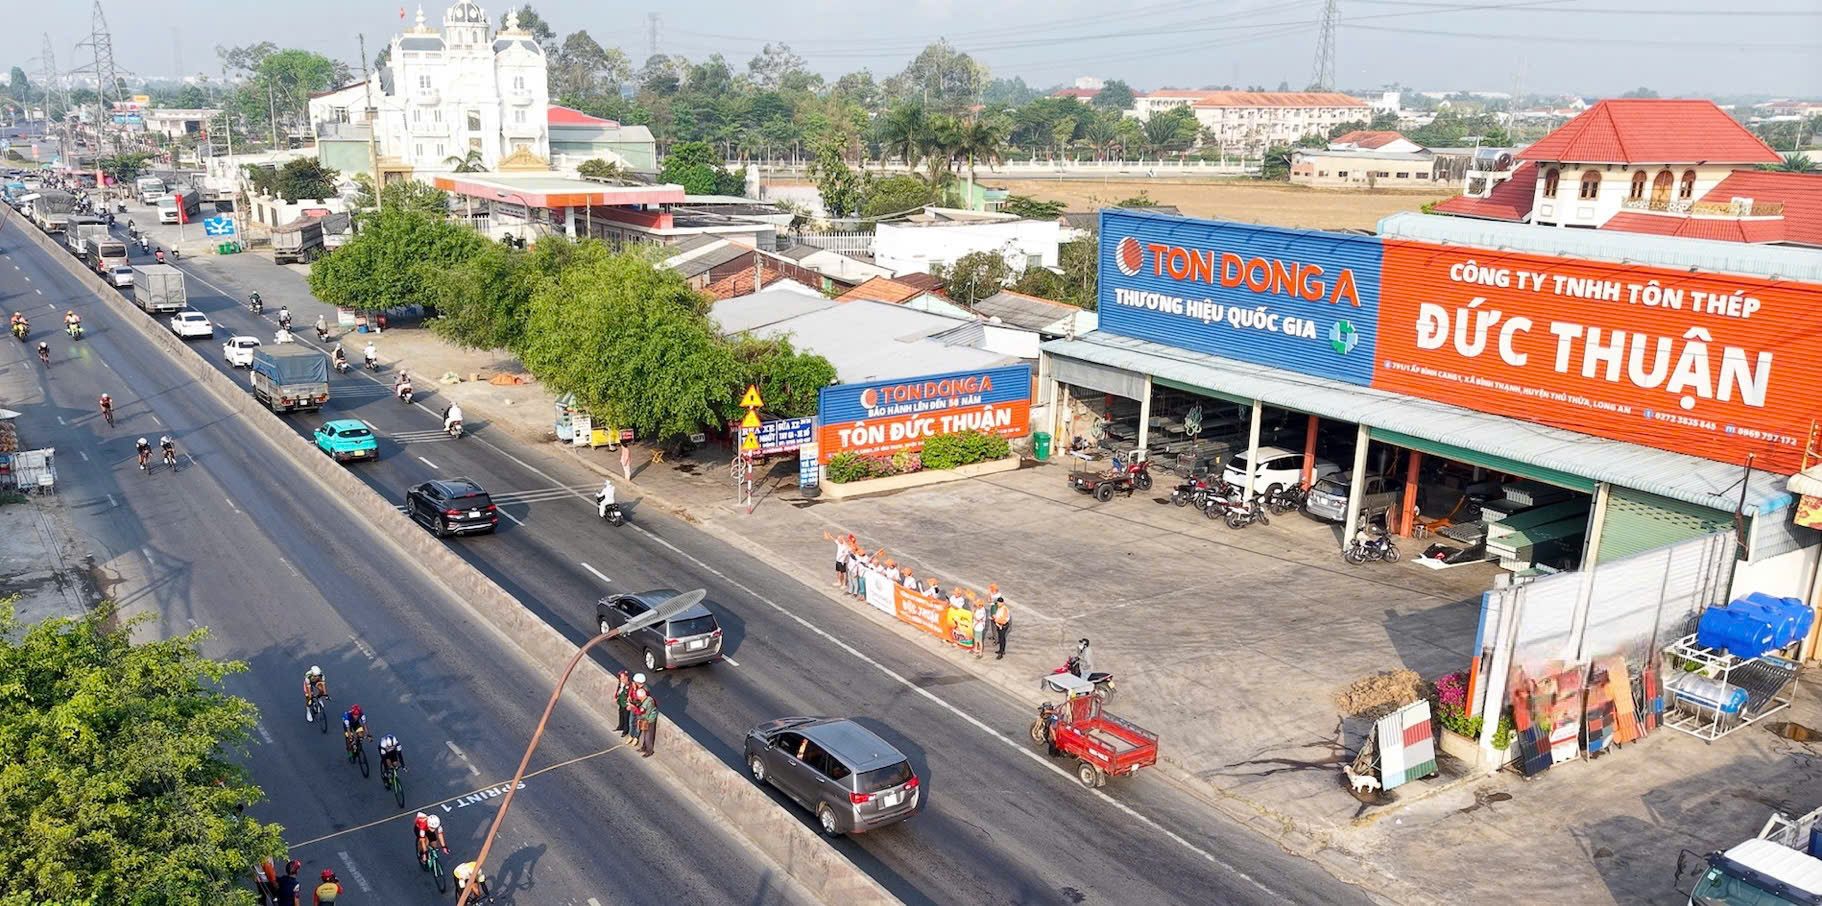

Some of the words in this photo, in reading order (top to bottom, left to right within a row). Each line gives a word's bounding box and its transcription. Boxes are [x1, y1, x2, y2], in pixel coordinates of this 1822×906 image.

[1147, 243, 1215, 285] TON
[1220, 252, 1325, 302] DONG
[1328, 268, 1362, 307] A
[1449, 260, 1510, 289] CÔNG
[1515, 270, 1547, 293] TY
[1552, 274, 1621, 303] TNHH
[1627, 280, 1684, 311] TÔN
[1690, 289, 1761, 319] THÉP
[1114, 287, 1184, 315] THƯƠNG
[1186, 298, 1224, 325] HIỆU
[1227, 306, 1279, 332] QUỐC
[1282, 317, 1317, 340] GIA
[1415, 296, 1533, 367] ĐỨC
[1549, 326, 1773, 411] THUẬN
[880, 385, 922, 405] TON
[924, 378, 976, 399] DONG
[977, 375, 993, 393] A
[868, 403, 886, 418] BẢO
[887, 402, 913, 416] HÀNH
[913, 400, 929, 413] LÊN
[929, 397, 946, 411] ĐẾN
[961, 395, 982, 406] NĂM
[1592, 399, 1616, 412] LONG
[1617, 403, 1631, 415] AN
[1655, 411, 1677, 423] 0272
[762, 424, 776, 433] XE
[838, 421, 886, 448] TÔN
[889, 413, 937, 440] ĐỨC
[940, 405, 1012, 435] THUẬN
[1737, 427, 1761, 439] 0969
[1780, 436, 1798, 446] 172
[440, 803, 452, 812] 1
[457, 780, 526, 808] SPRINT
